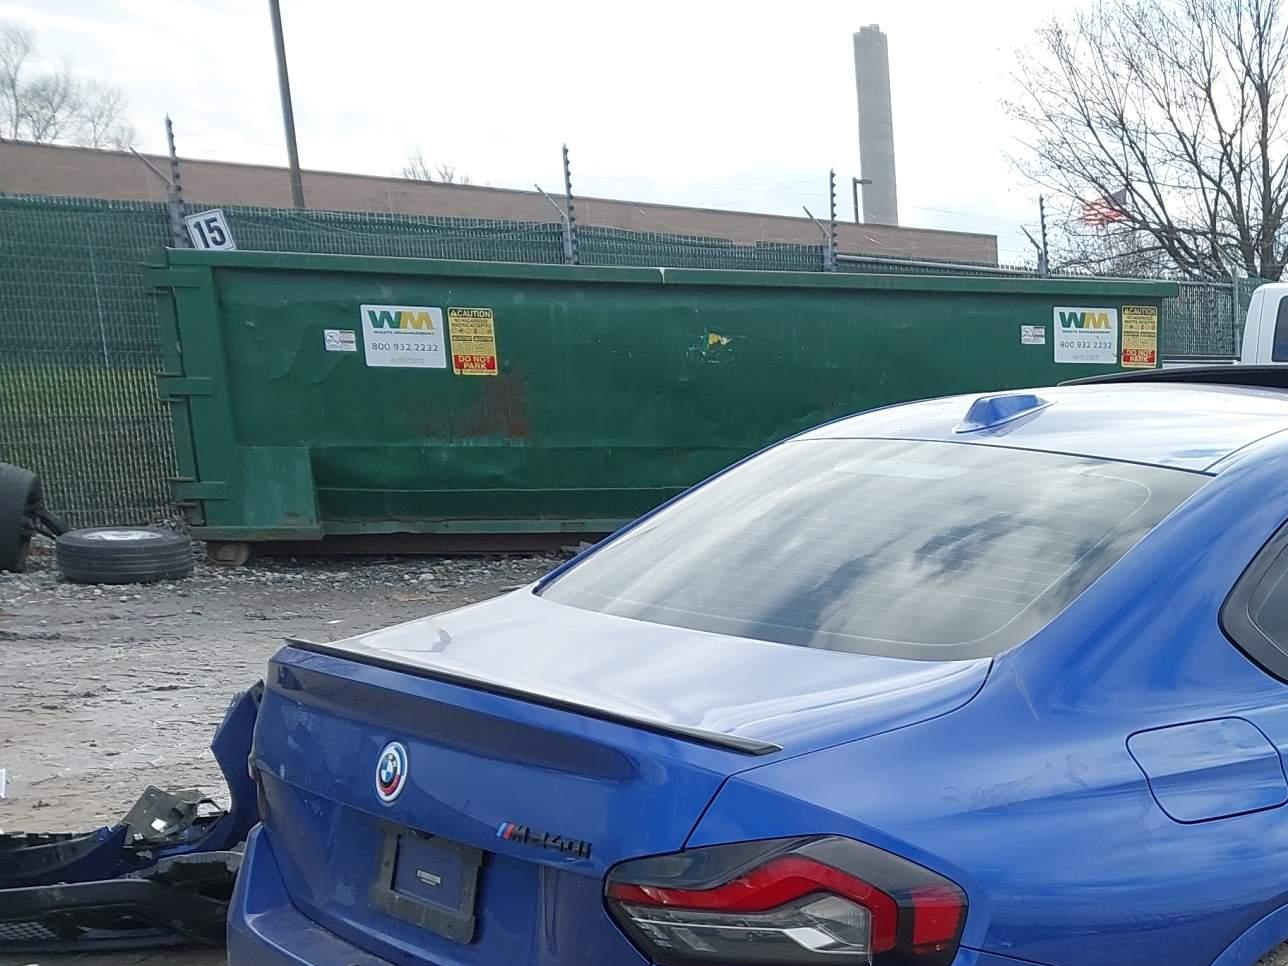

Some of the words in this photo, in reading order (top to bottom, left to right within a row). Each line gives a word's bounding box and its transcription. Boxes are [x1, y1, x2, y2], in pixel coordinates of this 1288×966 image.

[193, 216, 226, 249] 15
[367, 310, 434, 330] WM
[457, 310, 491, 318] CAUTION
[1059, 311, 1111, 329] WM
[372, 342, 390, 351] 800
[393, 343, 412, 351] 932
[414, 344, 439, 352] 2232
[1093, 341, 1113, 349] 2232
